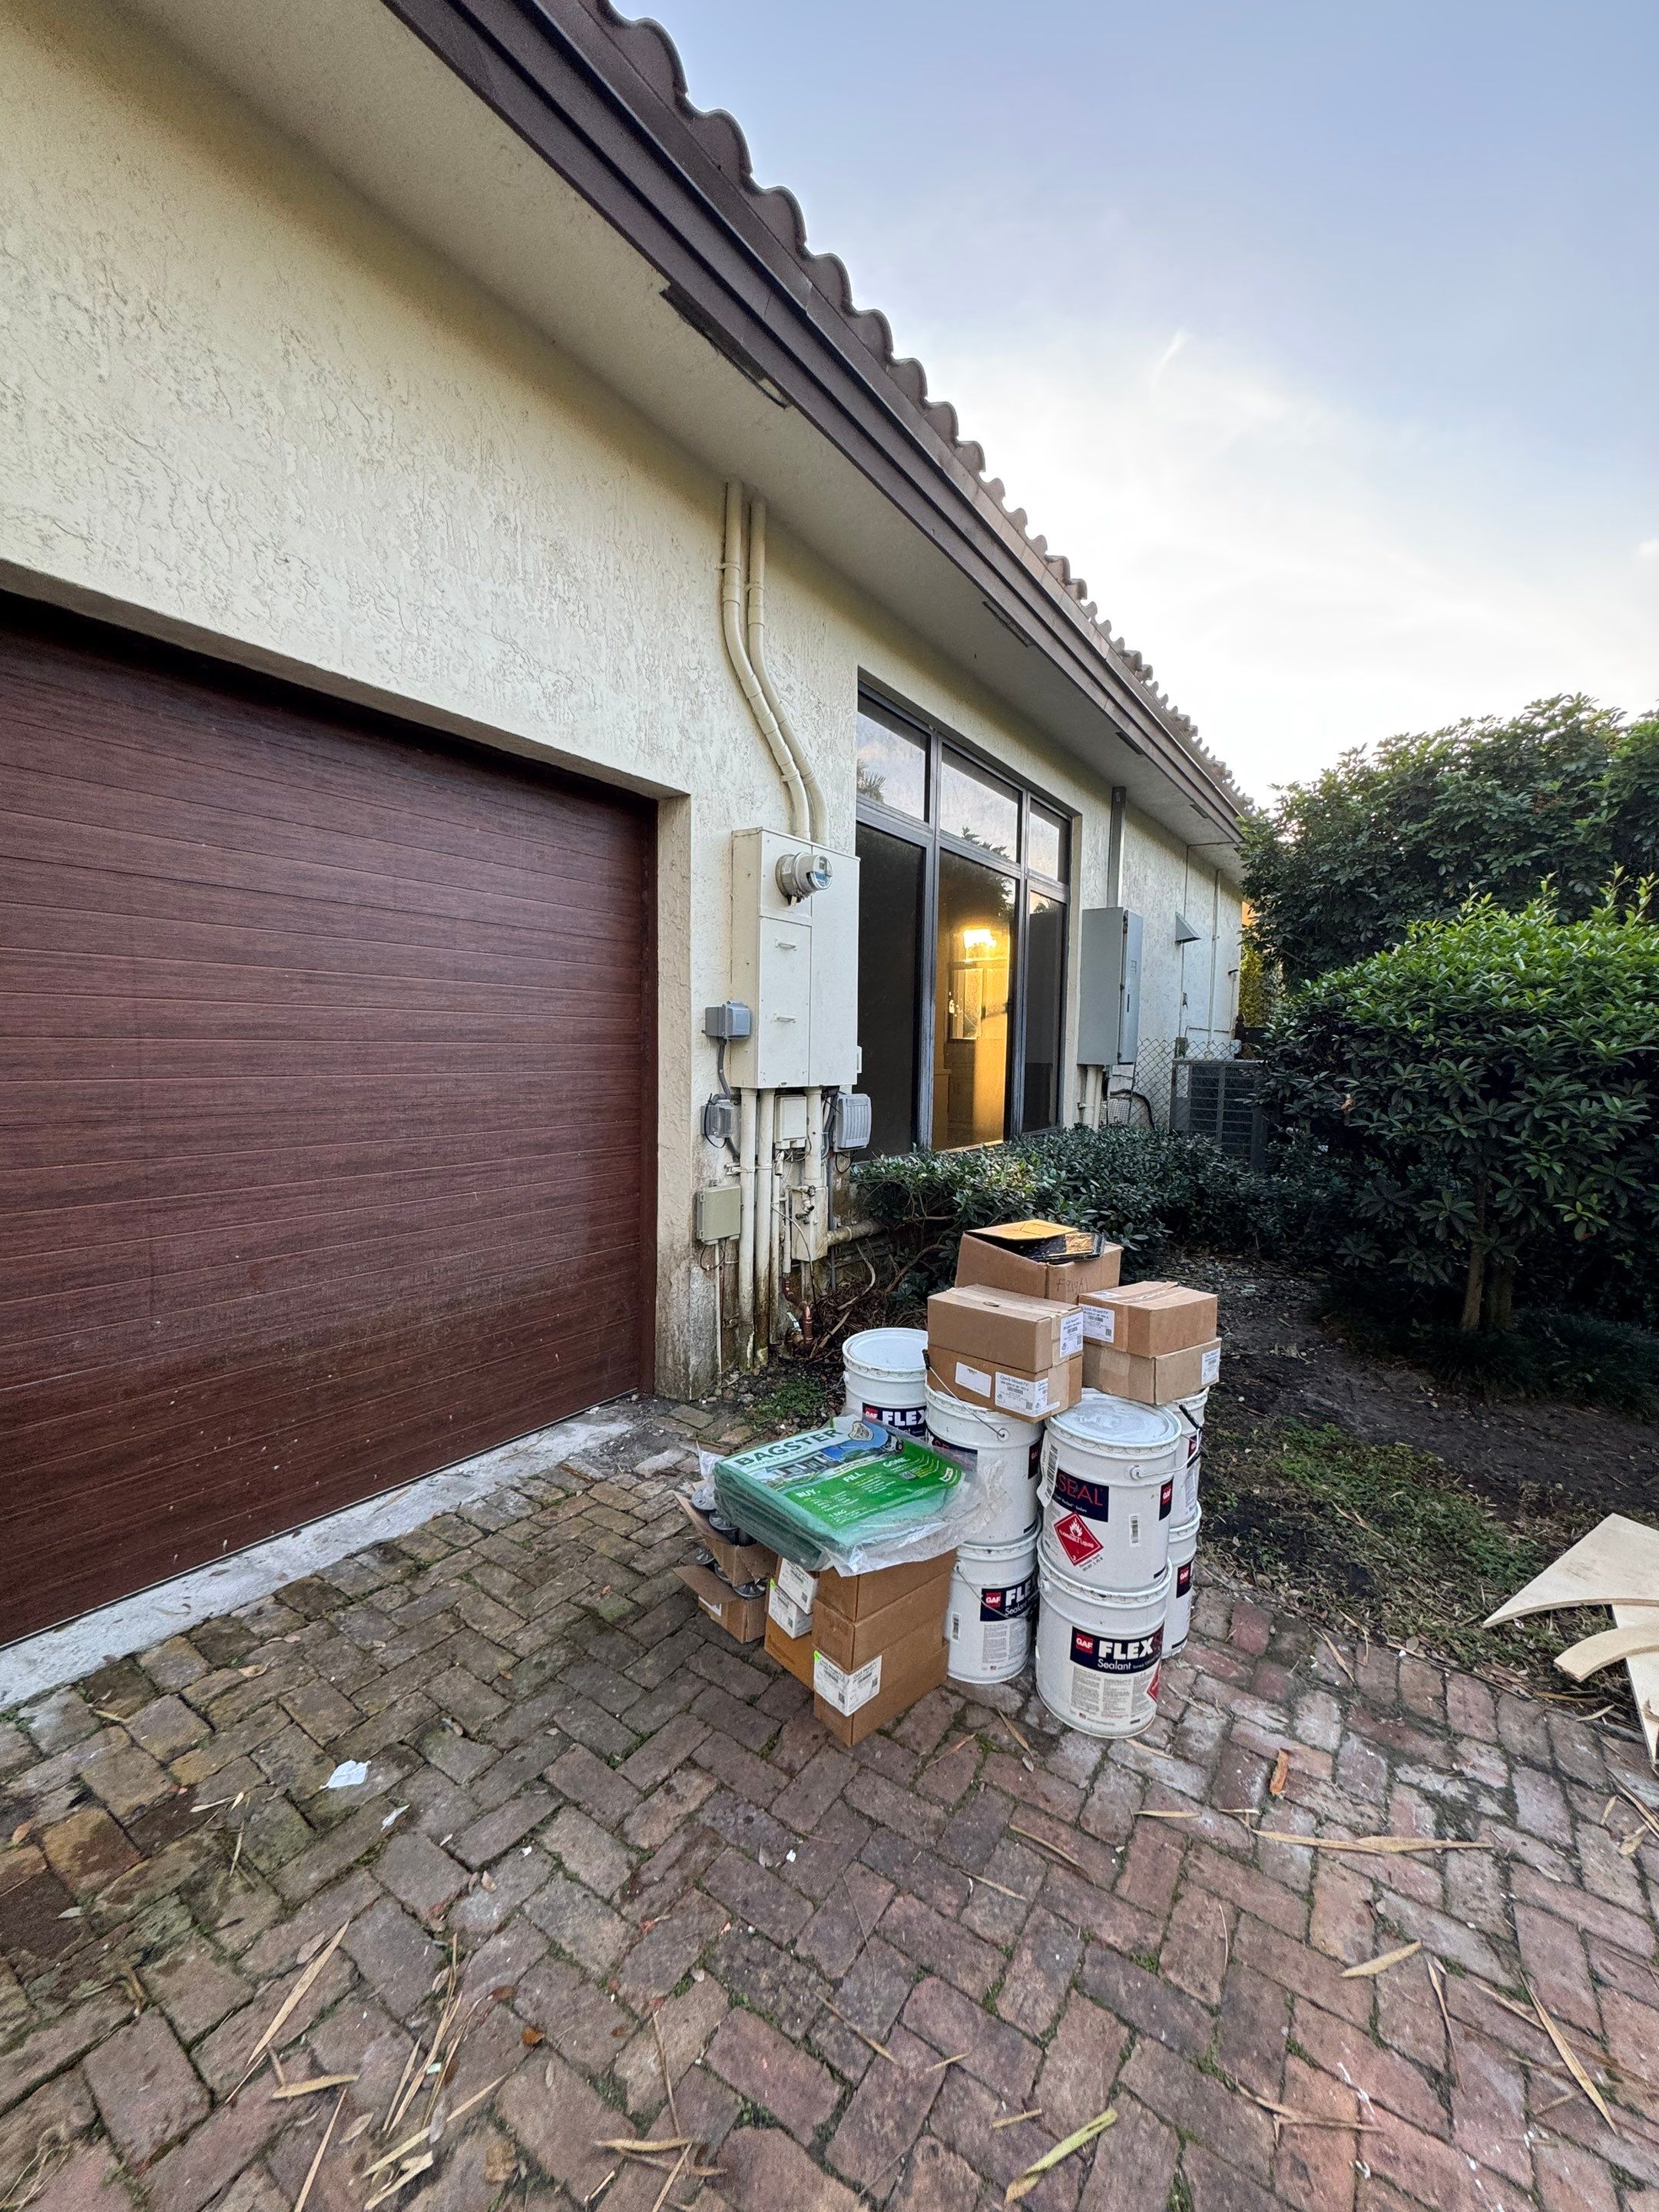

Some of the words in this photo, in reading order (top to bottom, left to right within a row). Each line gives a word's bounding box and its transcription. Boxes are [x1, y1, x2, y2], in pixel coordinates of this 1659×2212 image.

[734, 1429, 844, 1465] BAGSTER
[1058, 1473, 1104, 1507] SEAL
[1005, 1579, 1031, 1607] FLE
[1076, 1637, 1093, 1649] GAF
[1098, 1636, 1154, 1660] FLEX
[1098, 1658, 1131, 1671] Sealant
